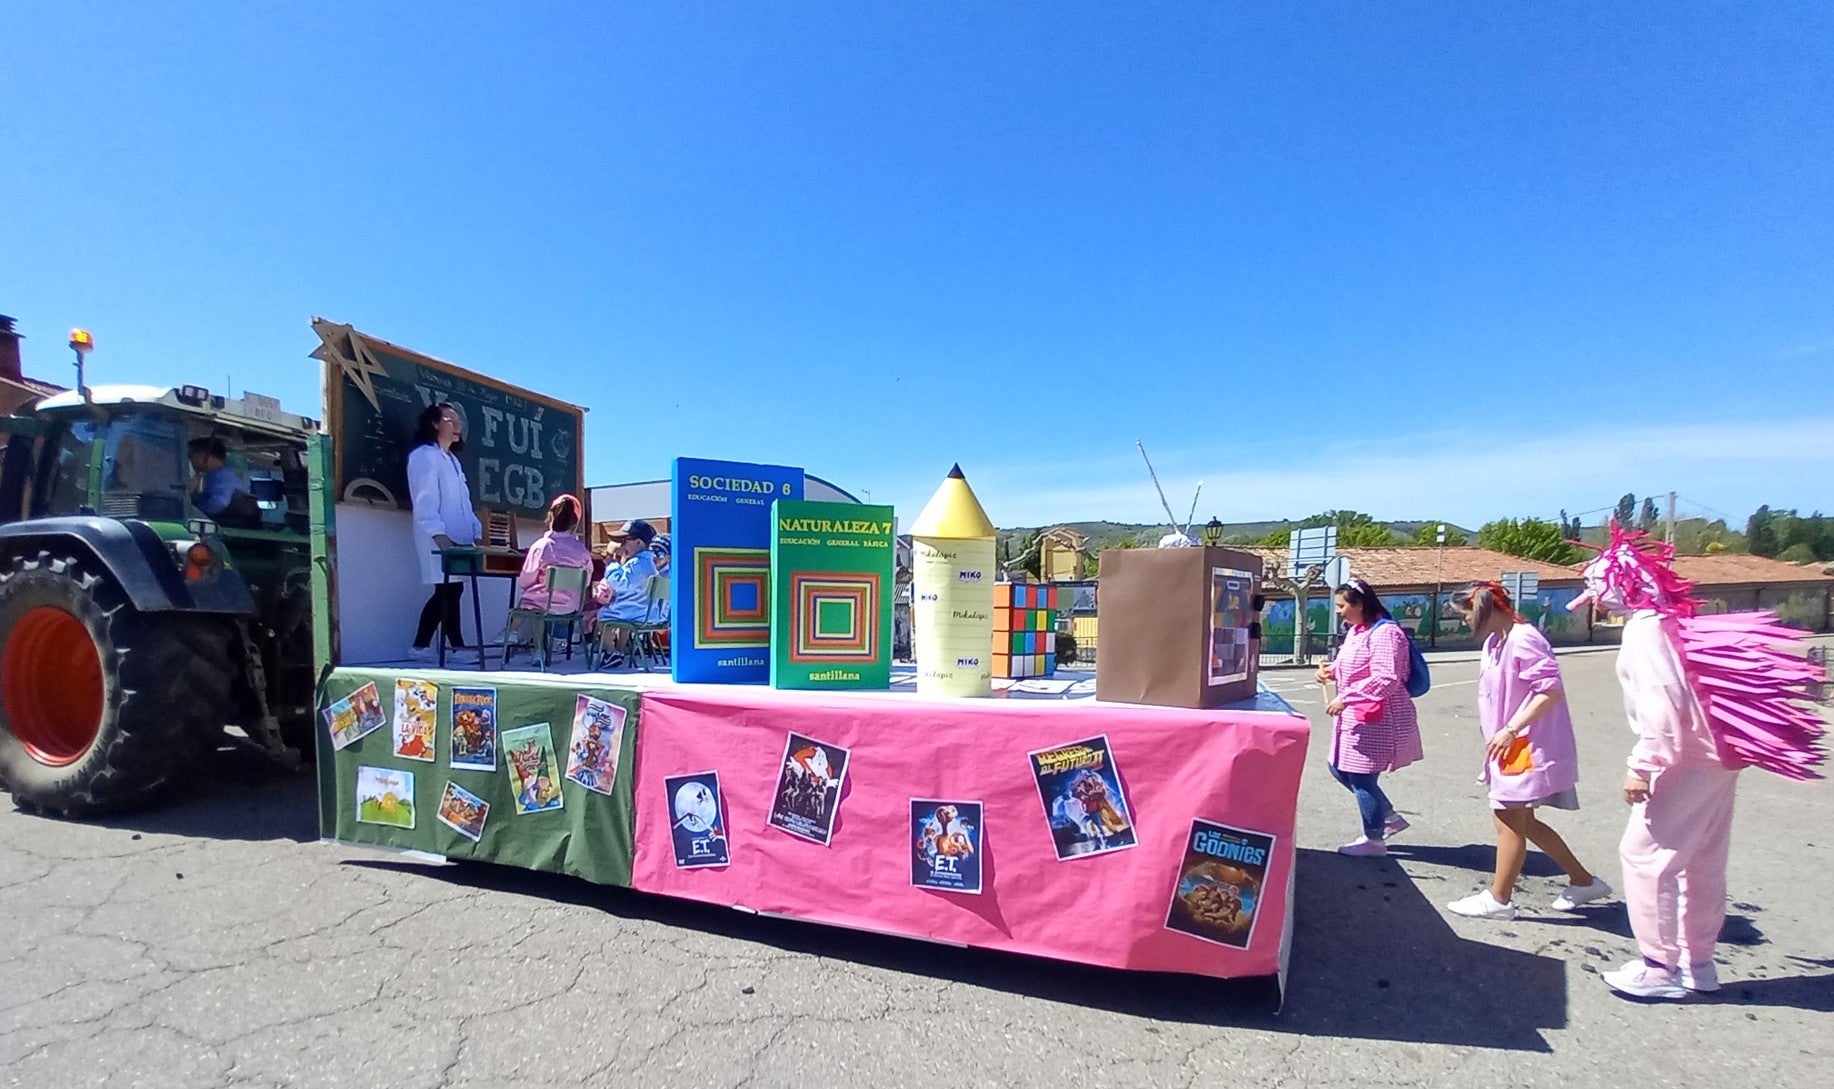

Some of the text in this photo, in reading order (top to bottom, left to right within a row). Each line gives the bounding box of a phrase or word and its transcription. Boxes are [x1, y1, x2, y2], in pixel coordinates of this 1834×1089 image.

[478, 457, 545, 509] EGB
[688, 475, 791, 496] SOCIEDAD 6
[687, 493, 765, 506] EDUCACIÓN GENERAL
[779, 518, 892, 535] NATURALEZA 7
[826, 539, 860, 547] GENERAL
[959, 570, 982, 580] MIKO
[921, 593, 938, 601] MIKO
[717, 656, 765, 667] santillana
[957, 658, 979, 667] MIKO
[808, 670, 860, 682] santillana
[692, 839, 711, 855] E.T.
[935, 855, 959, 873] E.T.
